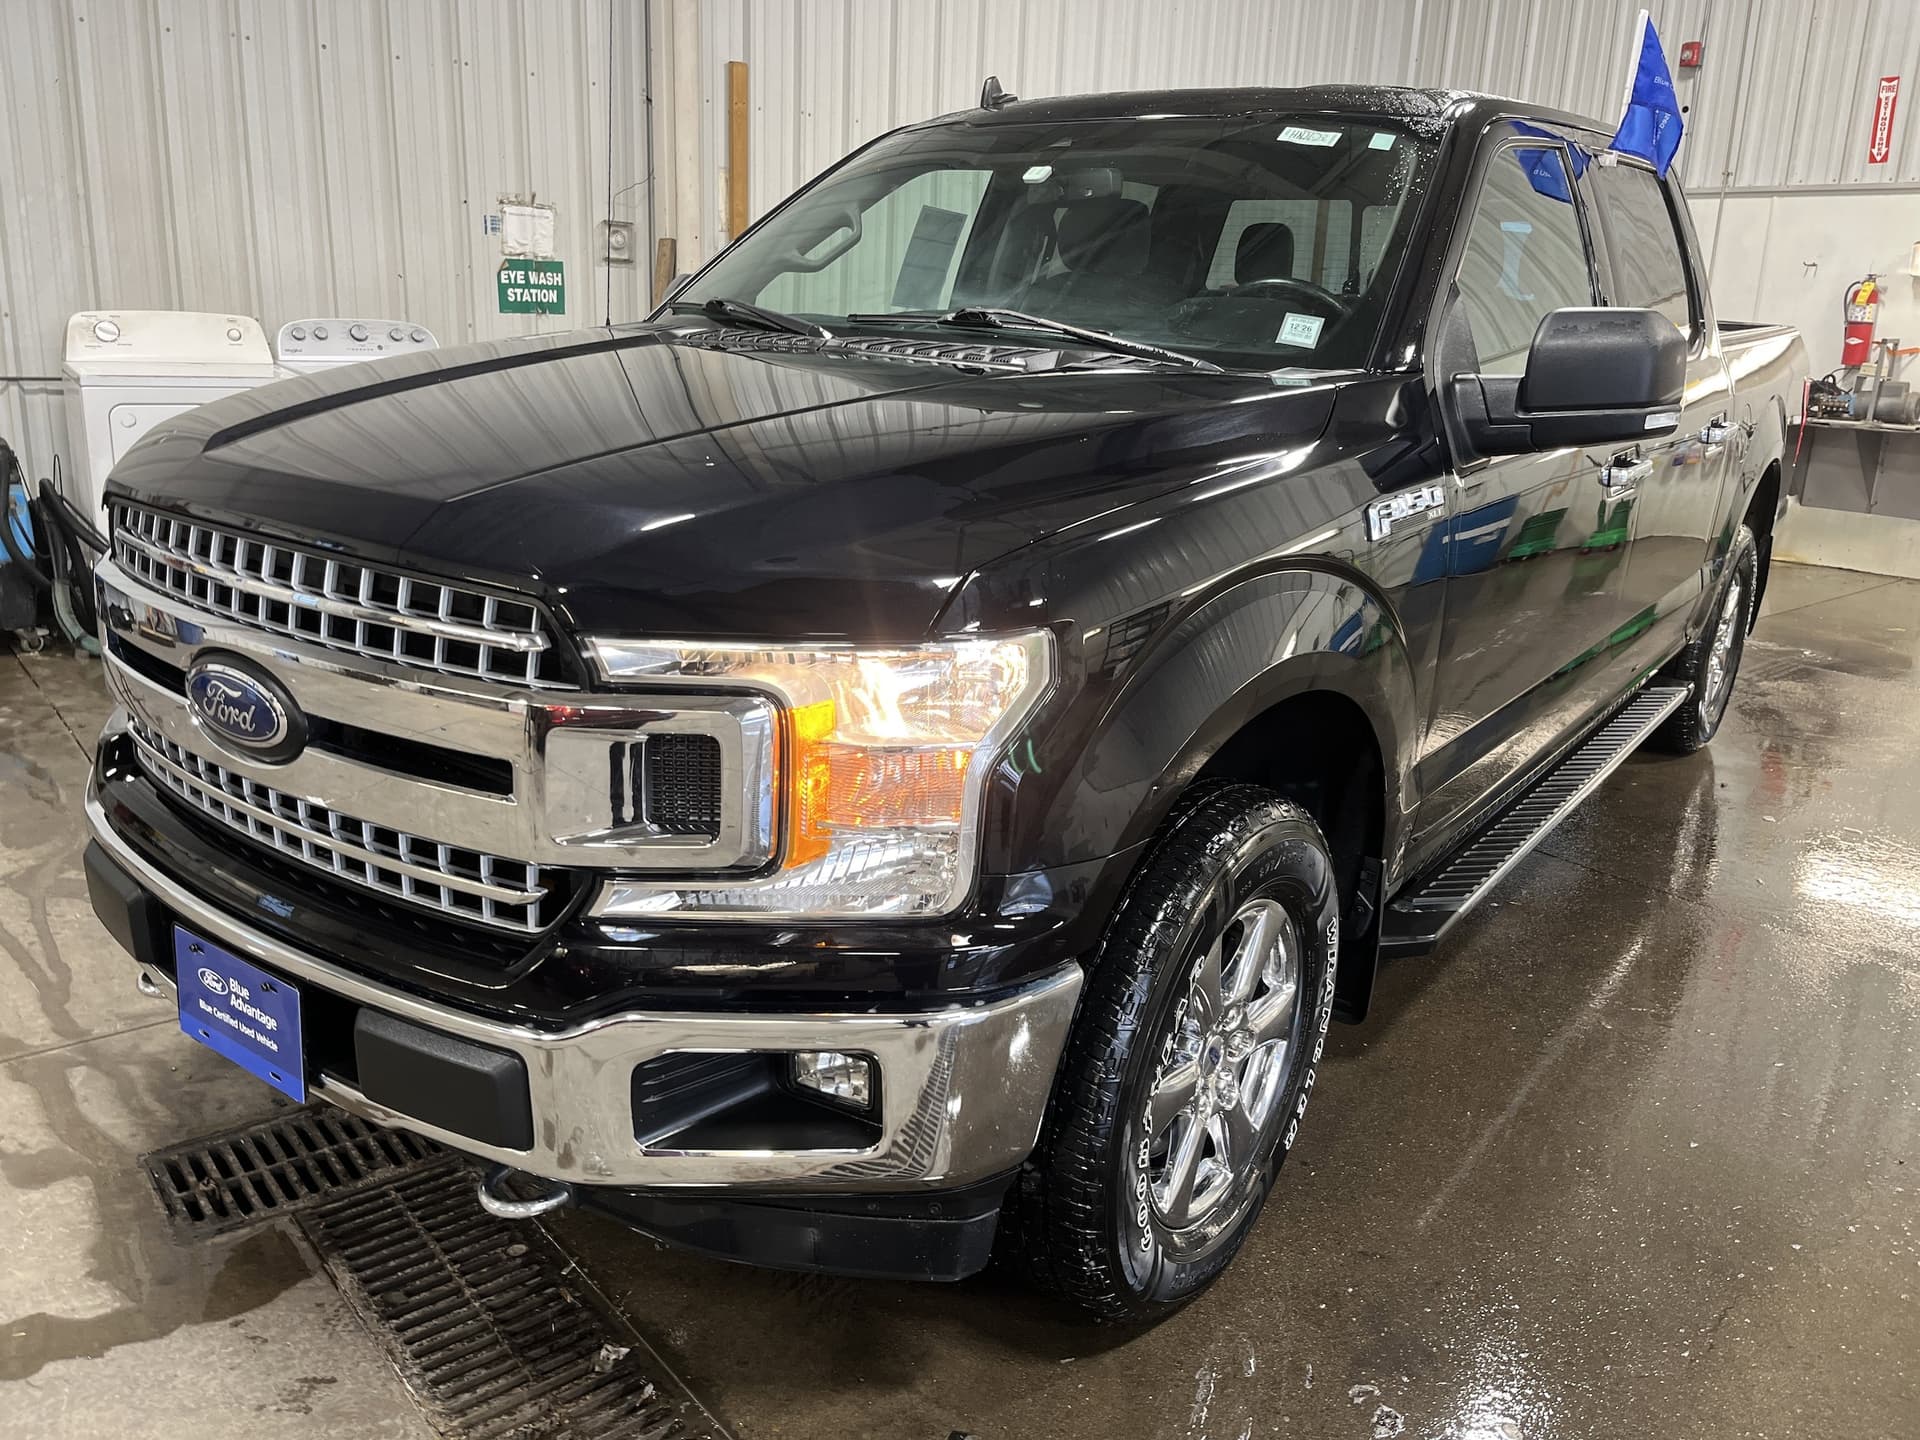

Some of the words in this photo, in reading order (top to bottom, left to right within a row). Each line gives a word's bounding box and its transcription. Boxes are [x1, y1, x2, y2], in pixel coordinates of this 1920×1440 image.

[1881, 84, 1897, 94] FIRE
[1876, 96, 1890, 157] EXTINGUISHER
[500, 270, 525, 284] EYE
[528, 271, 562, 286] WASH
[507, 287, 558, 303] STATION
[203, 680, 257, 732] Ford
[229, 976, 250, 1001] Blue
[199, 998, 213, 1015] Blue
[213, 1007, 239, 1030] Certified
[239, 1021, 255, 1039] Used
[255, 1031, 279, 1053] Vehicle
[230, 993, 278, 1031] Advantage
[1284, 915, 1338, 1151] WRANGLER
